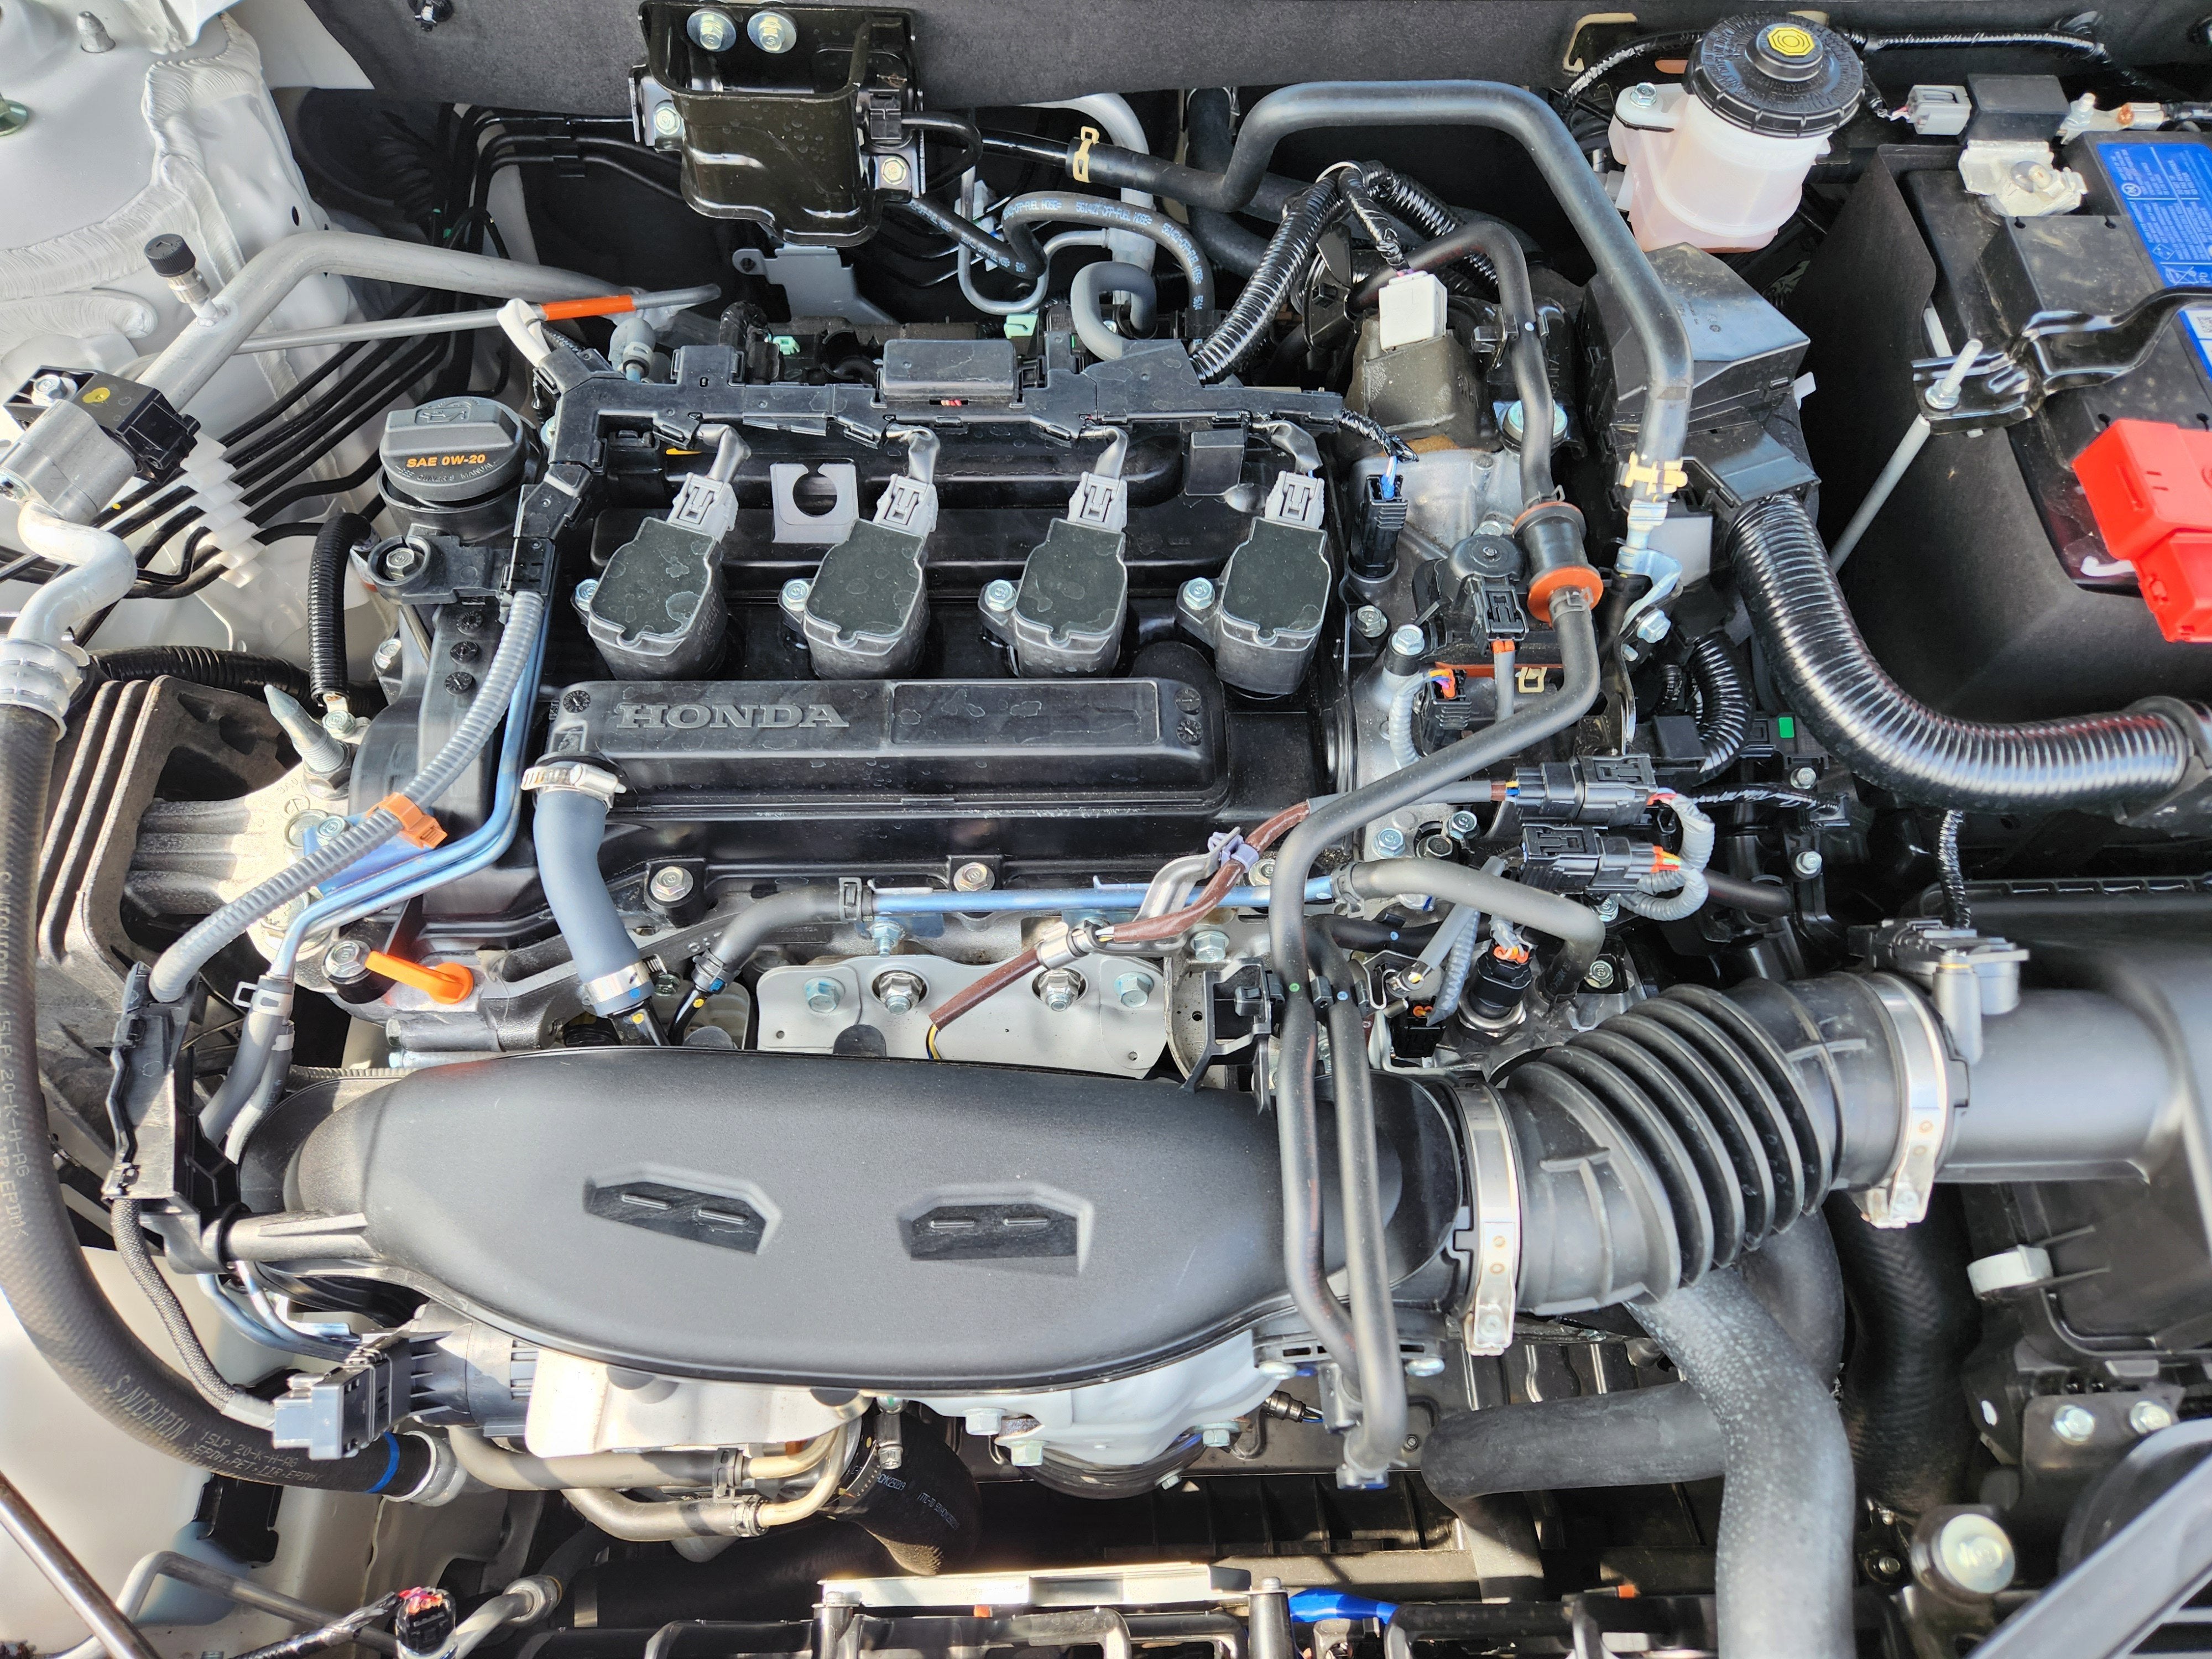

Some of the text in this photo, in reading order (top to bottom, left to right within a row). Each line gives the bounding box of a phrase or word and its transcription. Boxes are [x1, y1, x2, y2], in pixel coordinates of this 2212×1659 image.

[406, 454, 486, 468] SAE 0W-20
[417, 474, 455, 483] OWNER'S
[617, 704, 850, 729] HONDA
